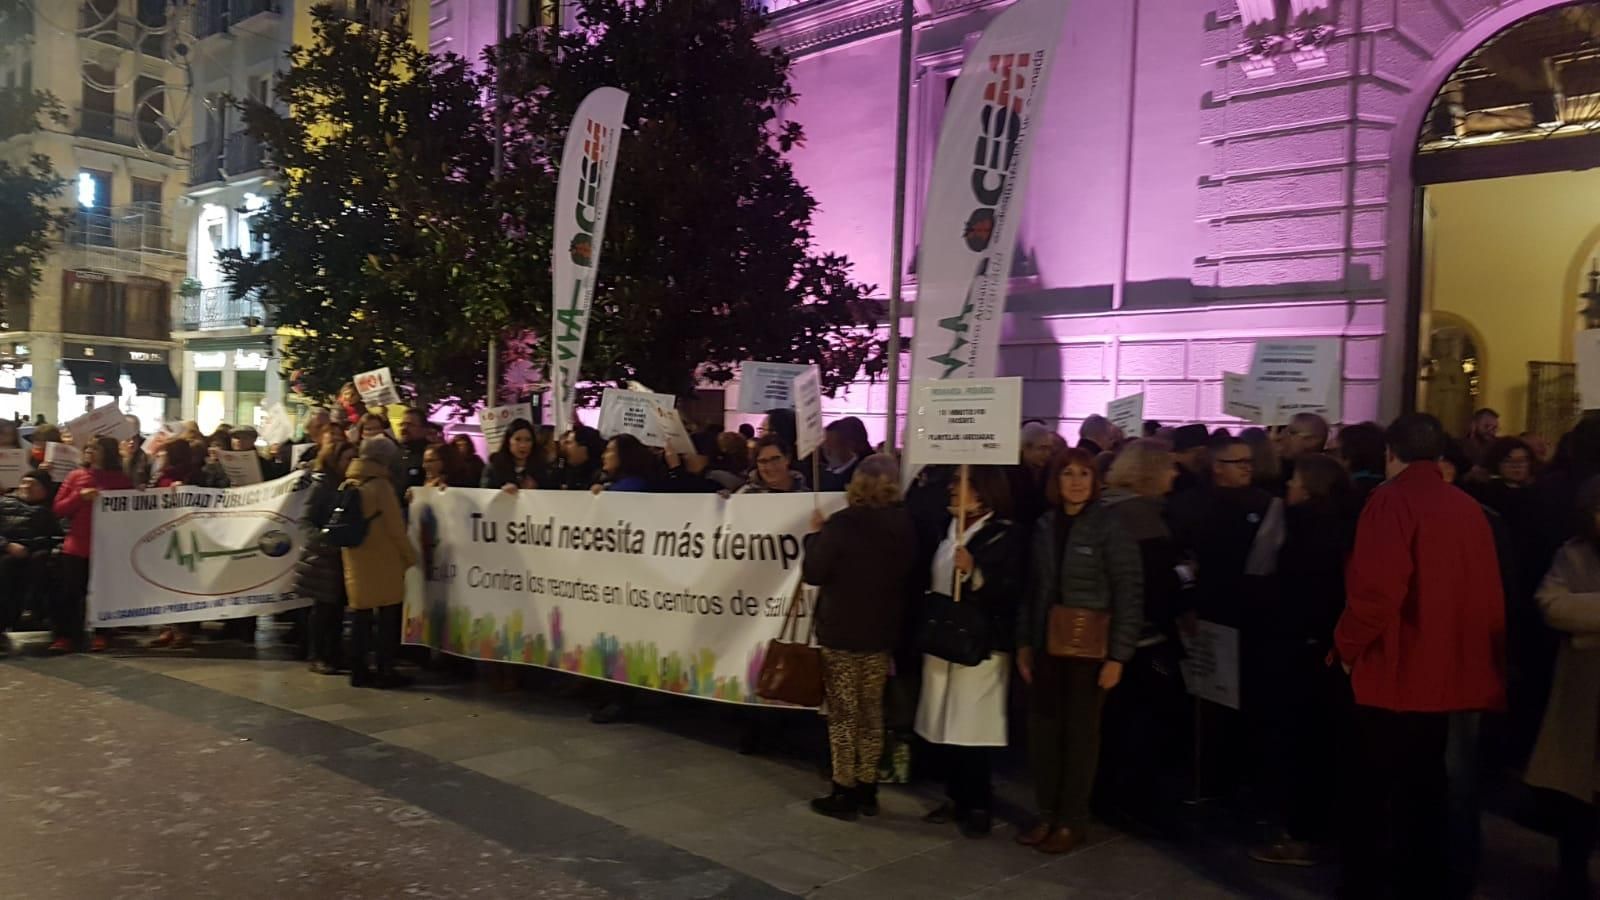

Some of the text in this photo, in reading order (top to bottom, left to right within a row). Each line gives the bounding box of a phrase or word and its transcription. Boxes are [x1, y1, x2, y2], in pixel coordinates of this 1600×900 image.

[102, 496, 127, 512] POR
[470, 512, 803, 570] Tu salud necesita más tiemp
[467, 565, 522, 592] Contra
[526, 569, 545, 595] los
[548, 576, 600, 602] recortes
[602, 586, 624, 605] en
[626, 581, 649, 609] los
[653, 588, 723, 616] centros
[730, 588, 760, 617] de
